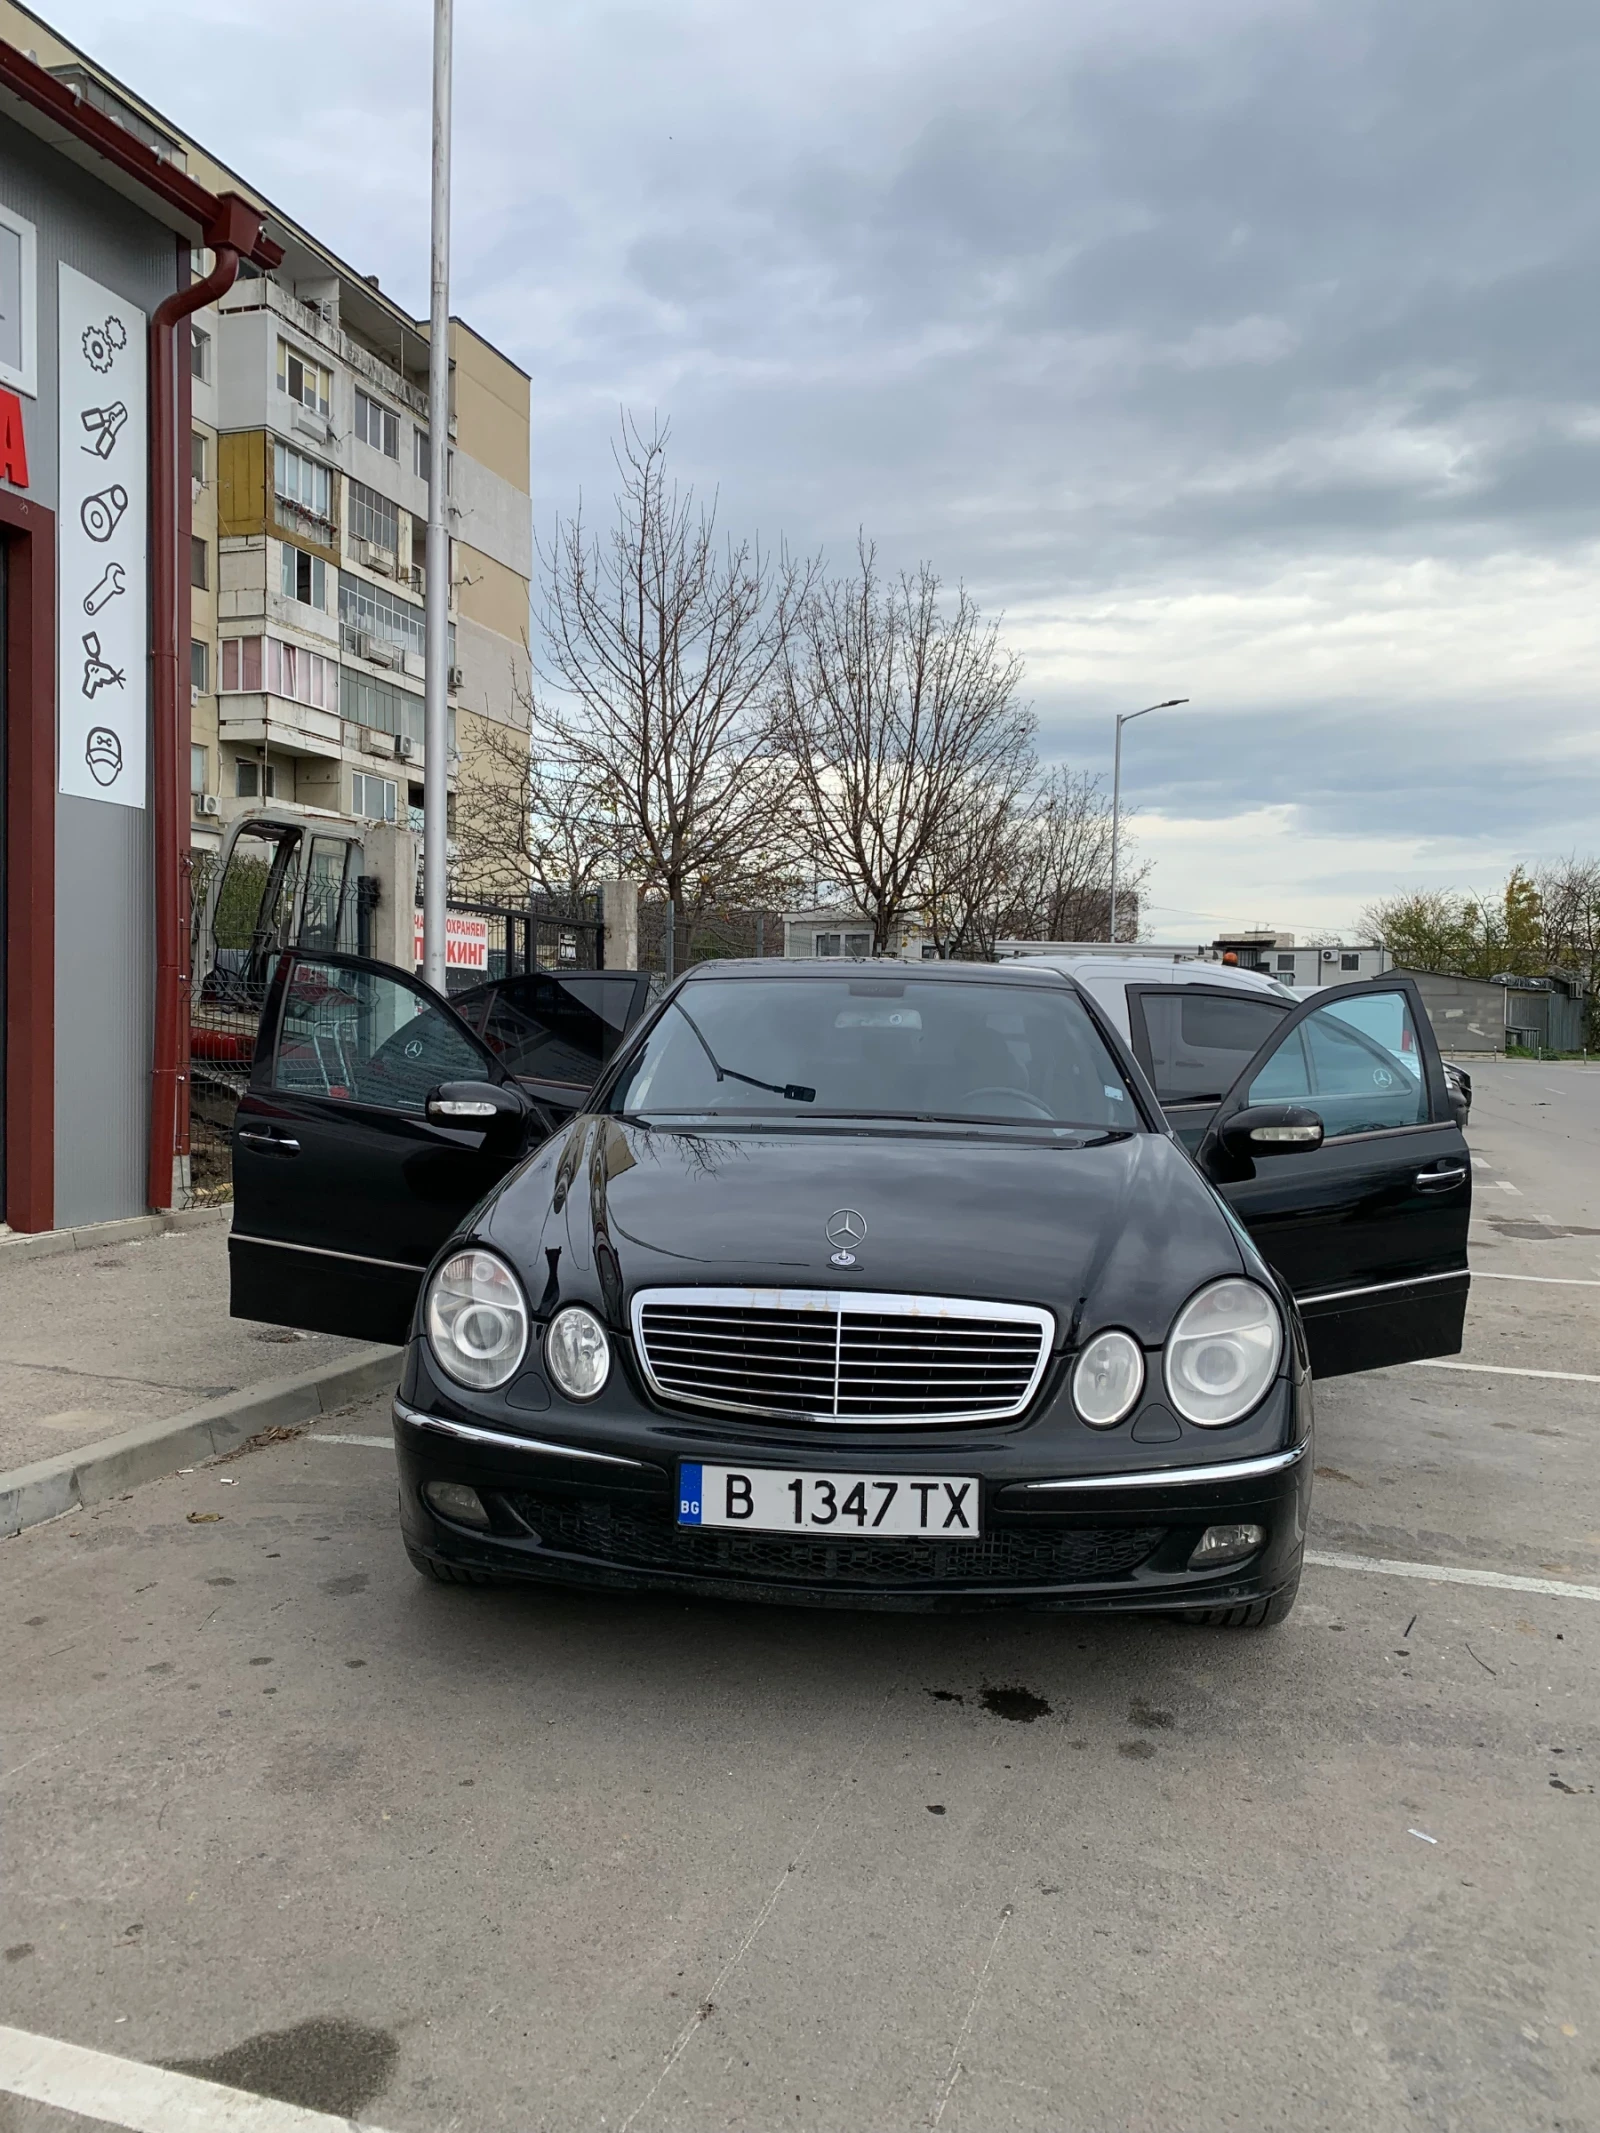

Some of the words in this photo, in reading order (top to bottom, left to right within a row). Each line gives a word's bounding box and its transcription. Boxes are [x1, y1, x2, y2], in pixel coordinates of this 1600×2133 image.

[446, 918, 486, 938] ОХРАНЯЕМ
[414, 936, 485, 966] ПКИНГ
[680, 1500, 700, 1515] BG
[726, 1474, 754, 1520] B
[788, 1478, 898, 1527] 1347
[910, 1482, 971, 1528] TX
